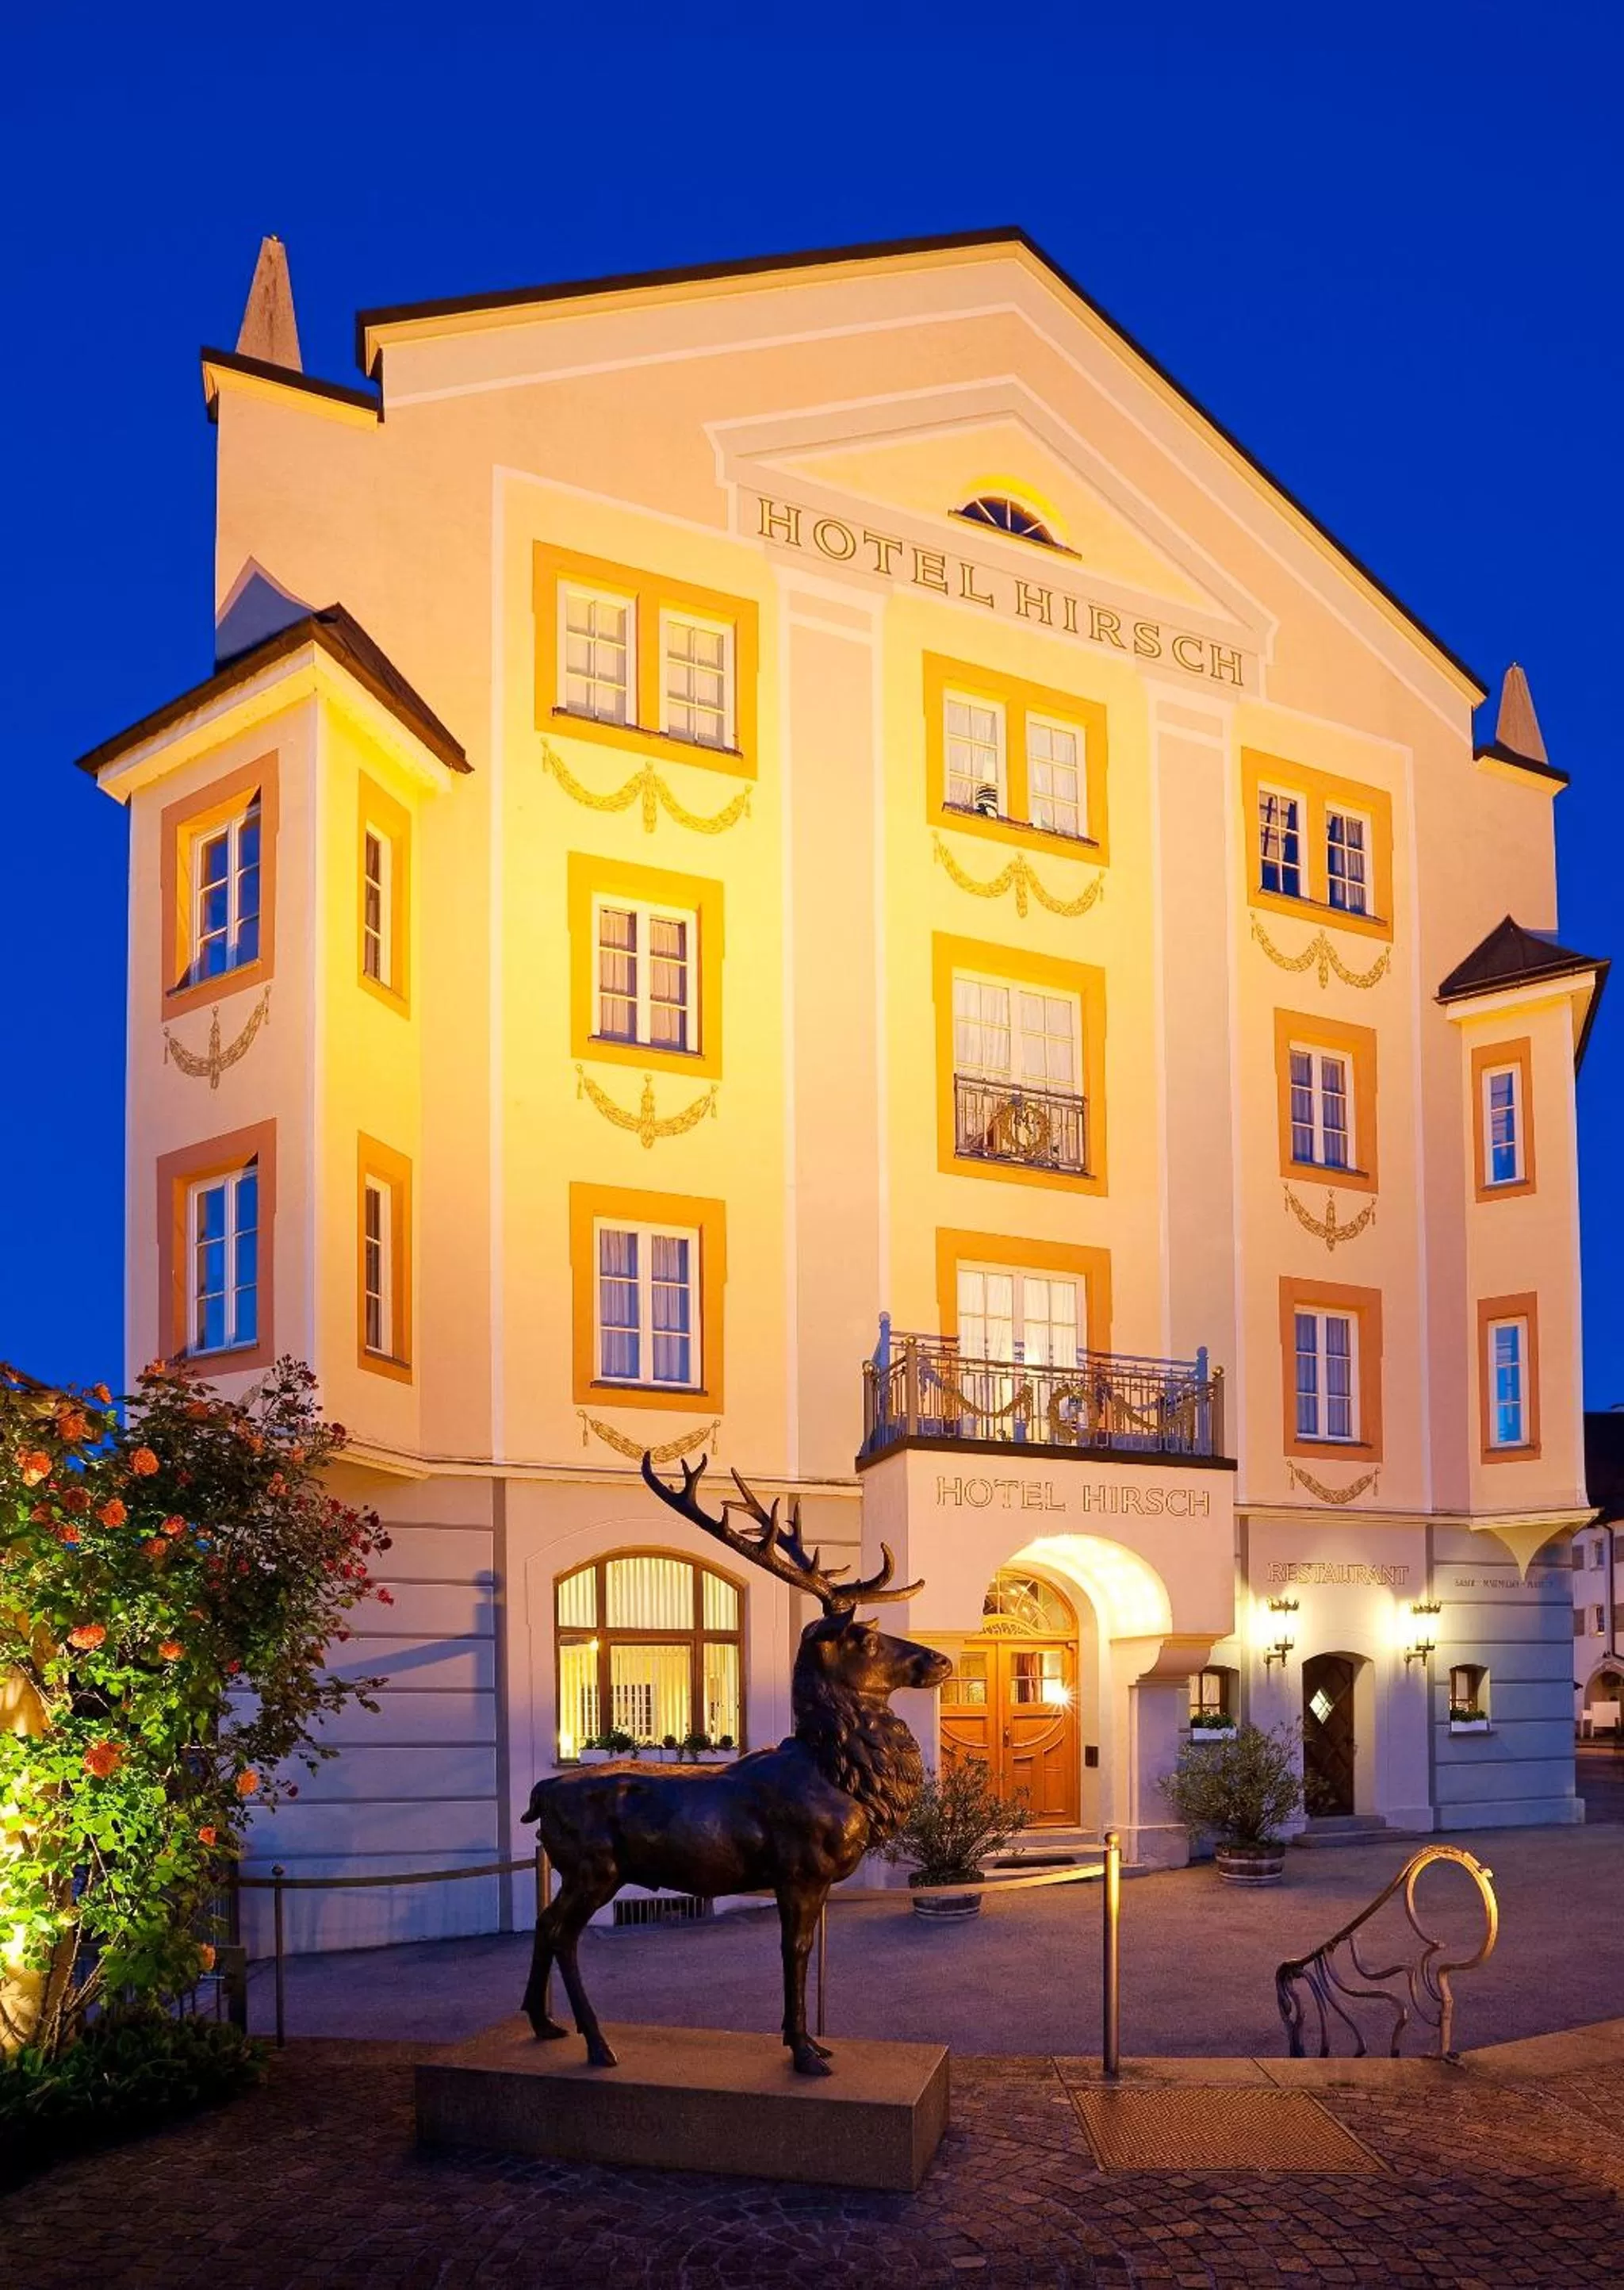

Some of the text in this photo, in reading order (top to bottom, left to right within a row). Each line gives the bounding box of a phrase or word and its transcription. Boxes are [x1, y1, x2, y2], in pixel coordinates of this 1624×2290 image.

[757, 497, 1244, 686] HOTEL HIRSCH
[936, 1476, 1209, 1517] HOTEL HIRSCH
[1268, 1563, 1409, 1586] RESTAURANT
